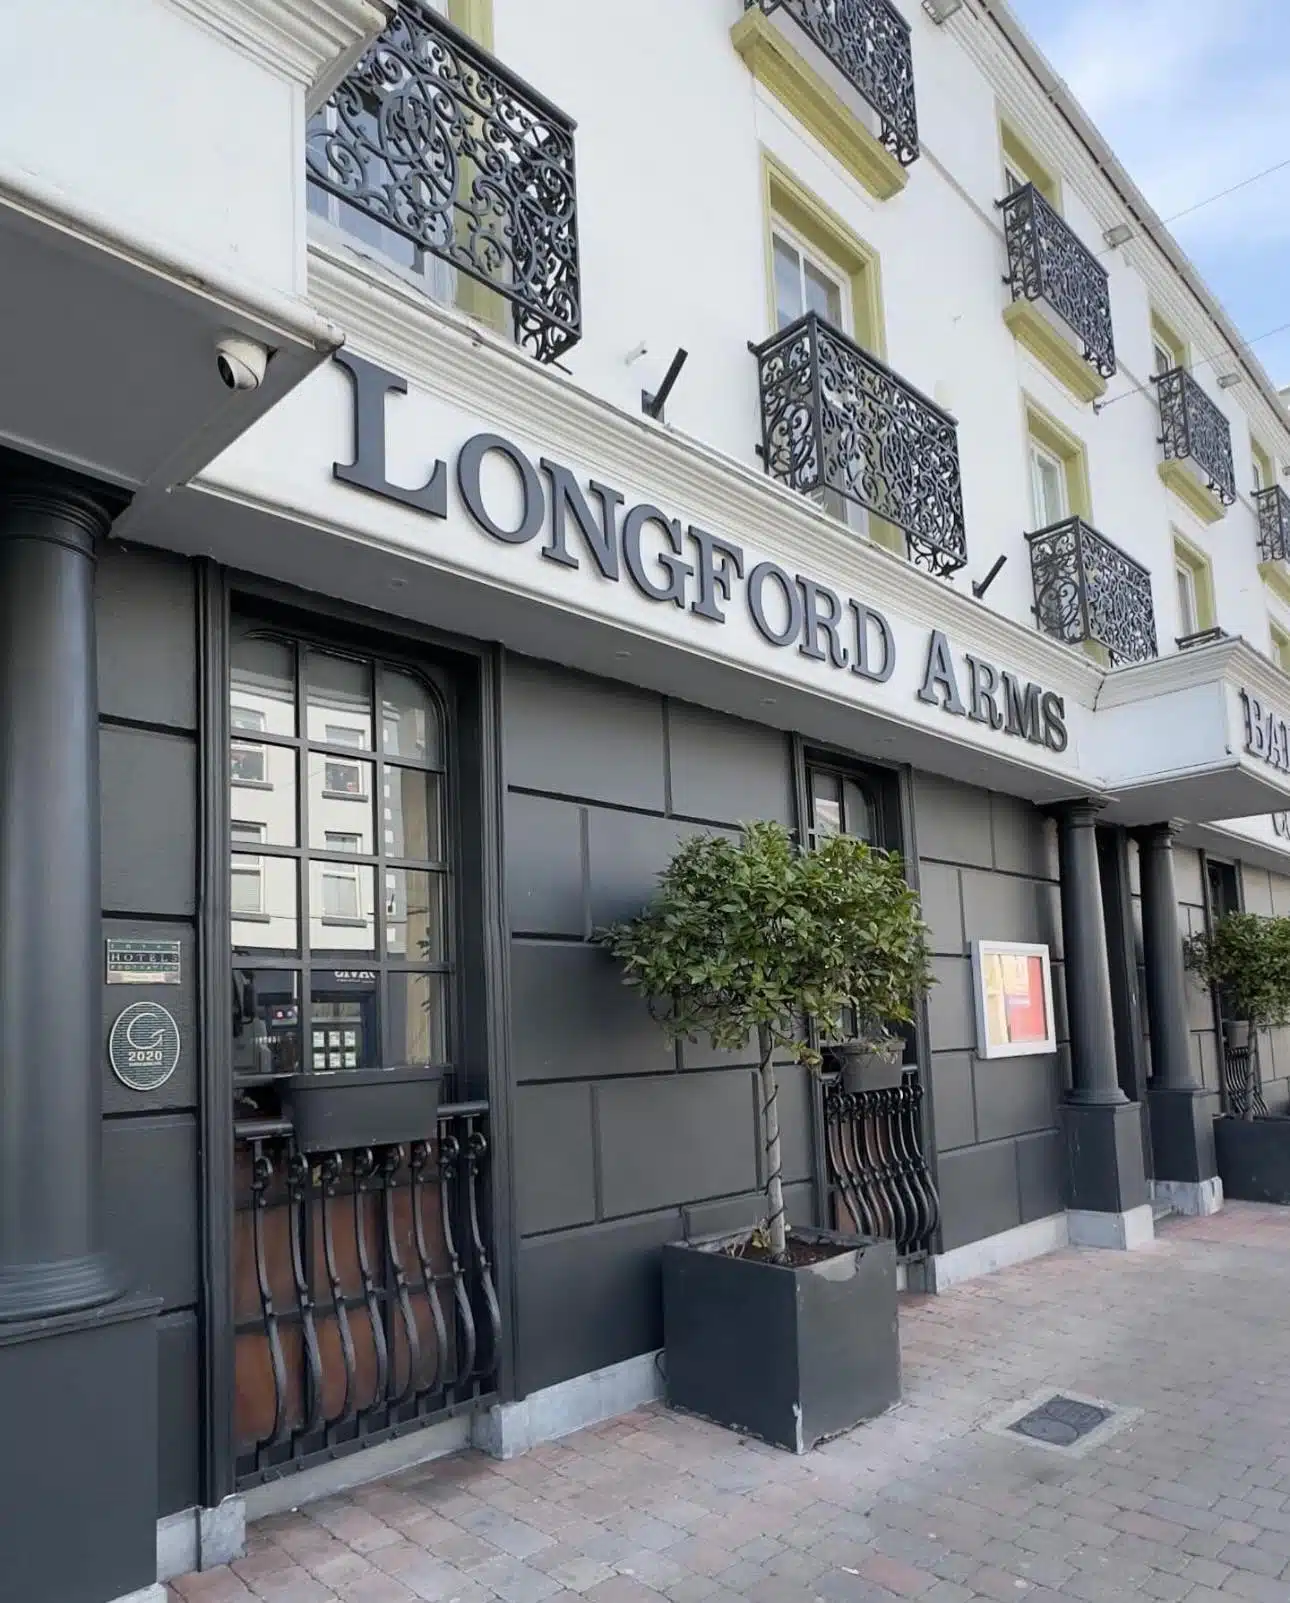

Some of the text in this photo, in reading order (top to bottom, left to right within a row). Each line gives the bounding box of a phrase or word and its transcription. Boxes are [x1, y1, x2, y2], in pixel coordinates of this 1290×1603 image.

[332, 349, 1068, 753] LONGFORD ARMS
[128, 1051, 163, 1062] 2020
